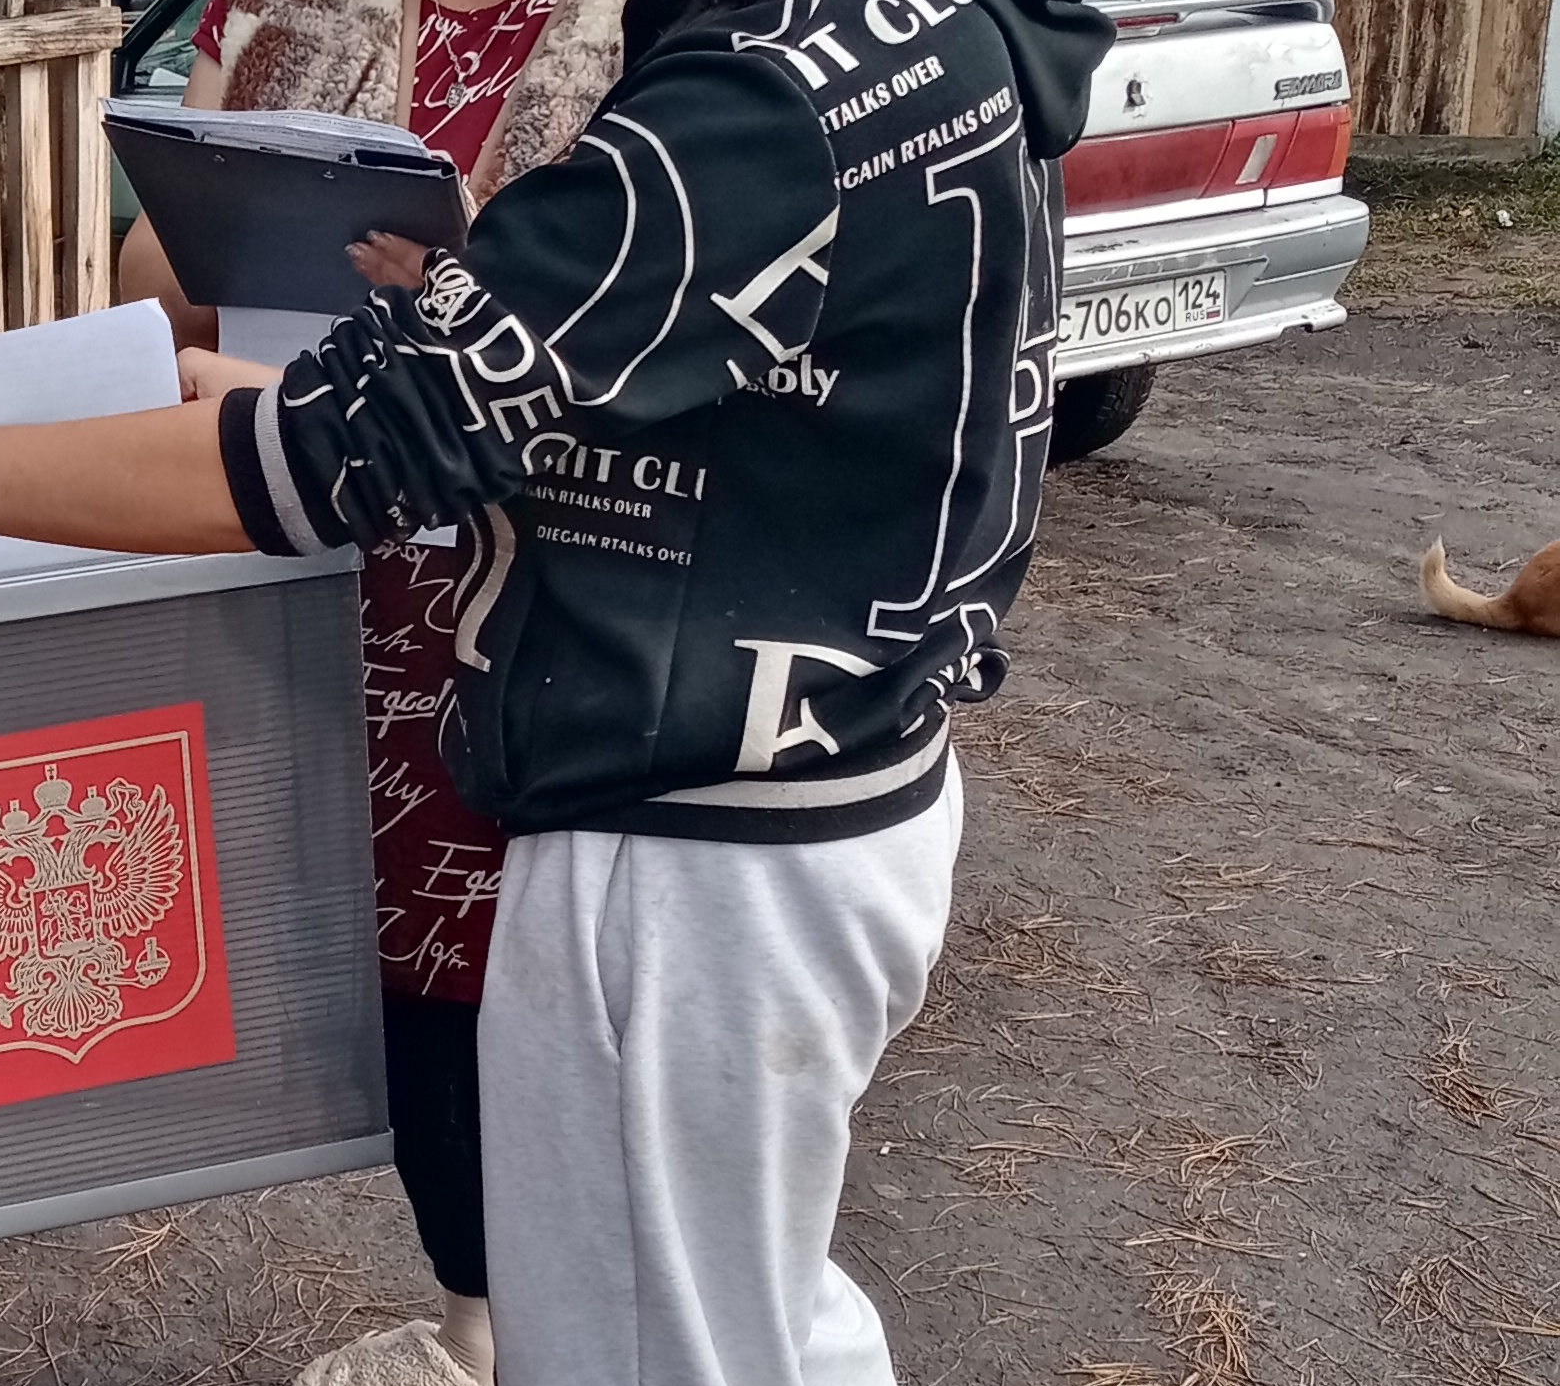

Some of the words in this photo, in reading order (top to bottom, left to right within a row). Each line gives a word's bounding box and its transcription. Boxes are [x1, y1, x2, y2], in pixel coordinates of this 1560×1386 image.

[891, 55, 945, 98] OVER
[900, 108, 979, 163] RTALKS
[980, 86, 1014, 125] OVER
[1178, 276, 1220, 311] 124
[1185, 309, 1206, 323] RUS
[559, 490, 611, 512] RTALKS
[614, 499, 652, 519] OVER
[600, 536, 654, 558] RTALKS
